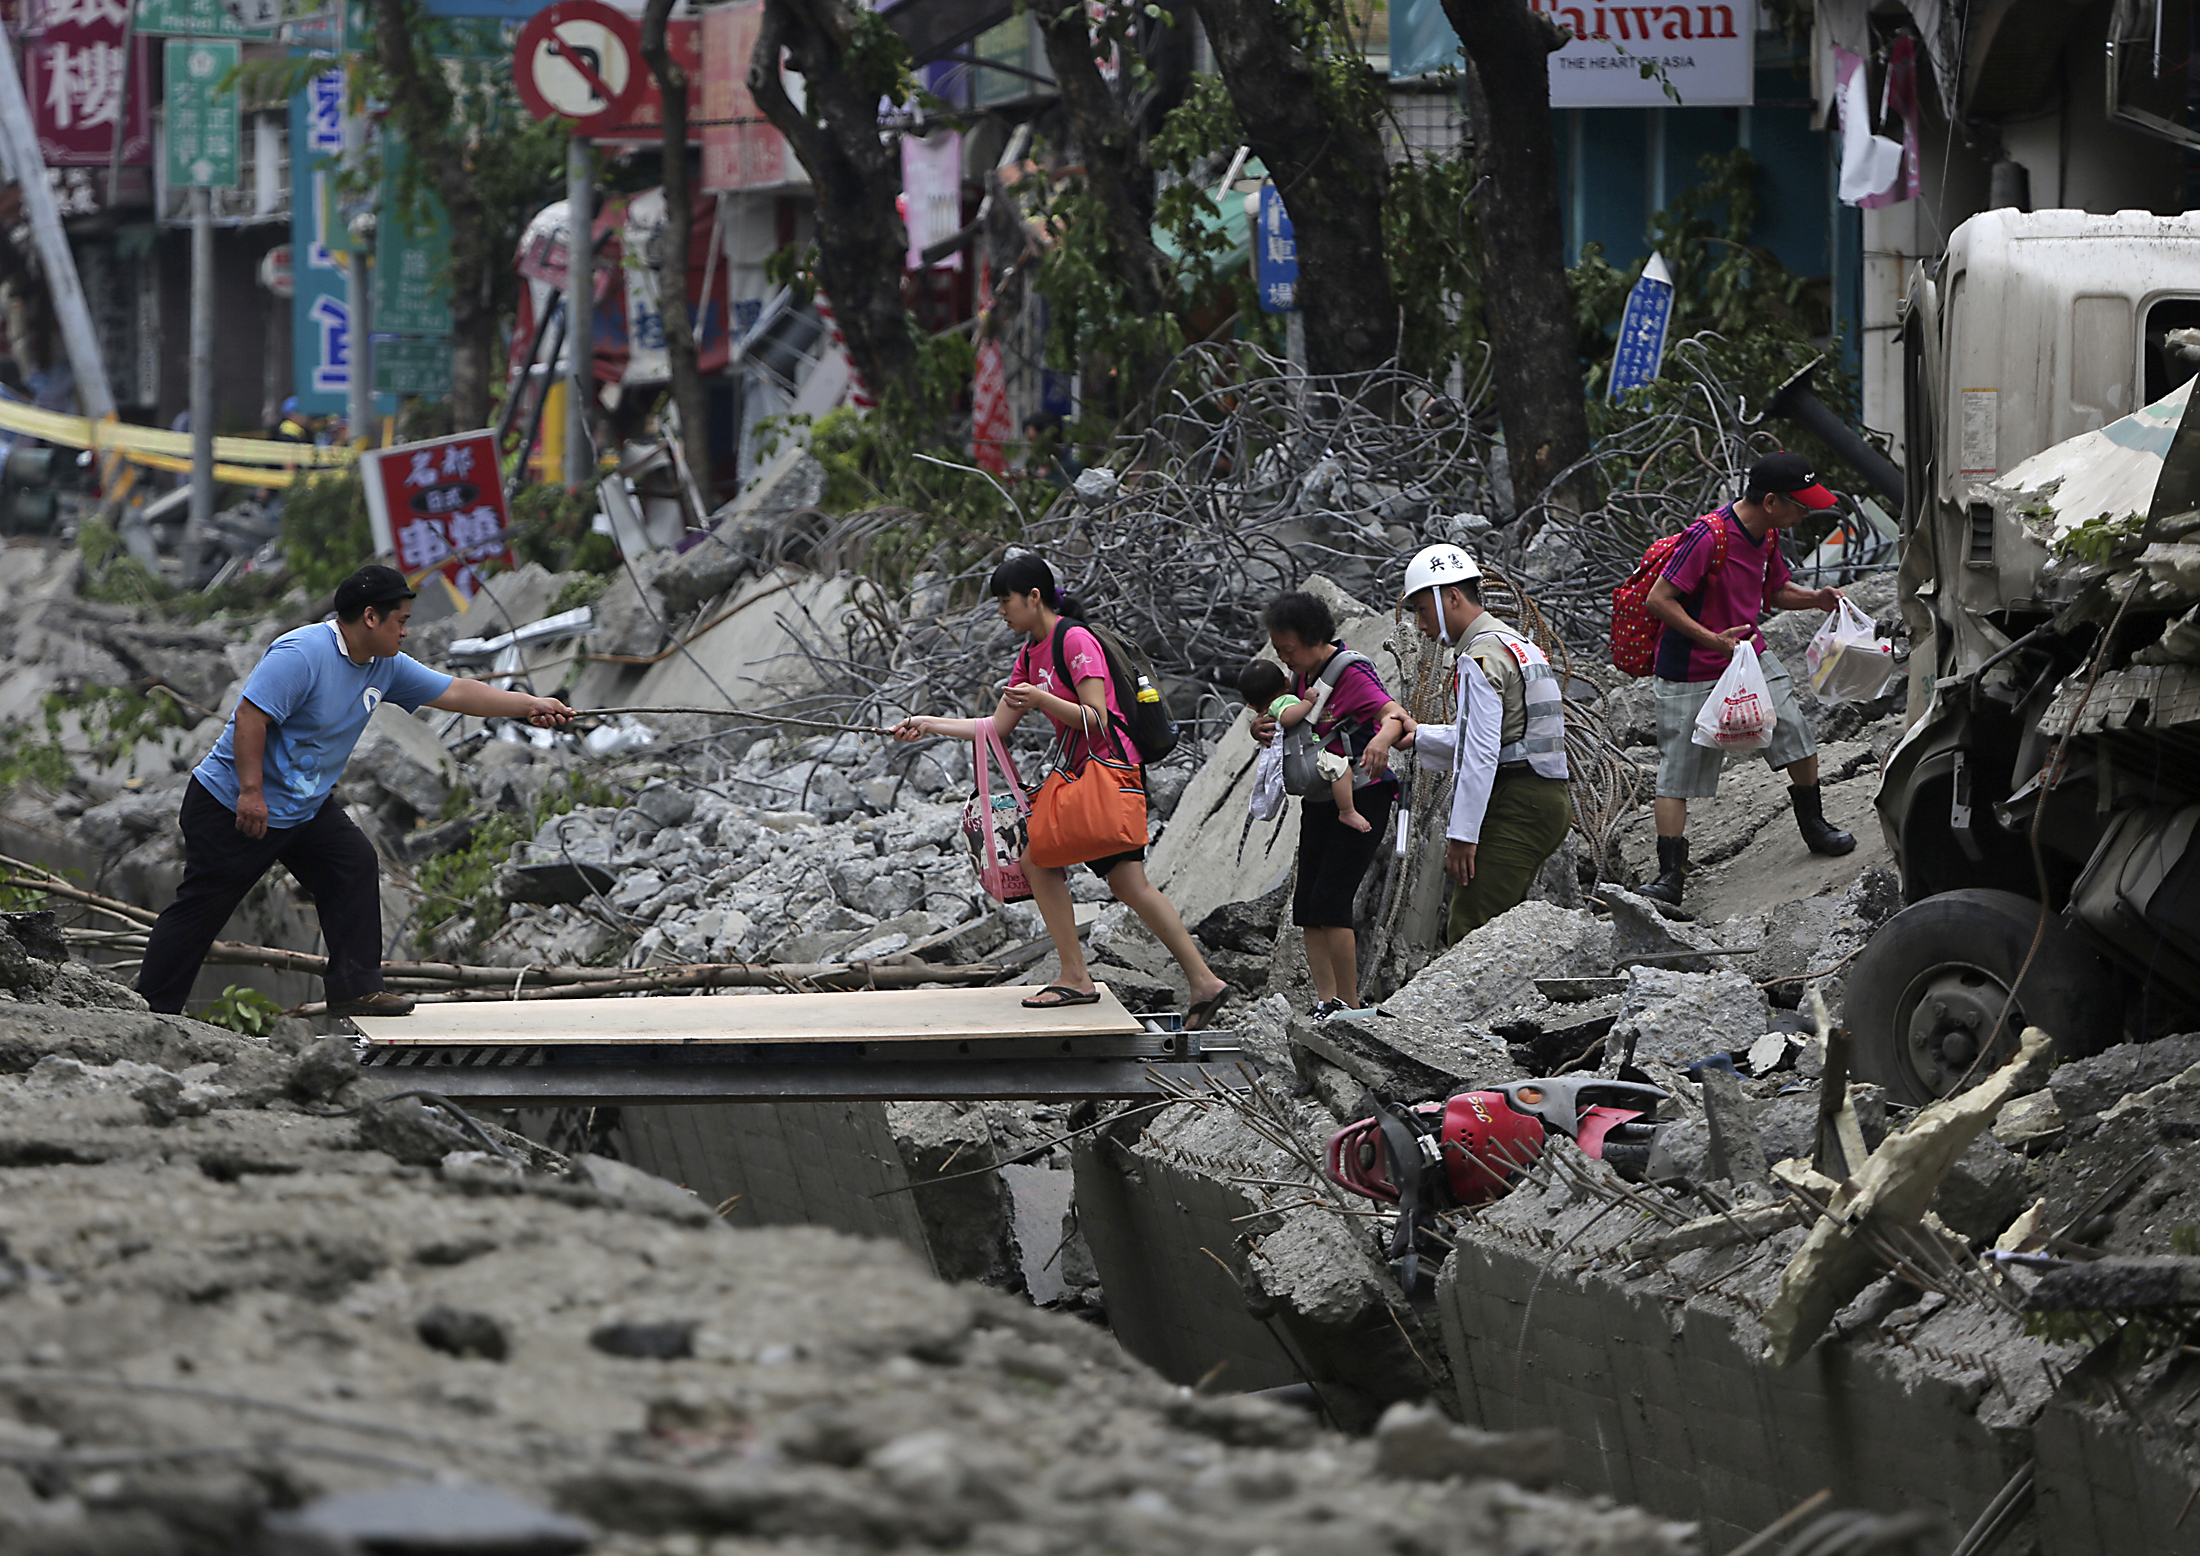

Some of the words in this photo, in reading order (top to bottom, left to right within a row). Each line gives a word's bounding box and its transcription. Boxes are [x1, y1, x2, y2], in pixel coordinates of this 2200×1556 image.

[1560, 57, 1585, 69] THE
[1589, 57, 1635, 69] HEART
[1662, 56, 1696, 68] ASIA
